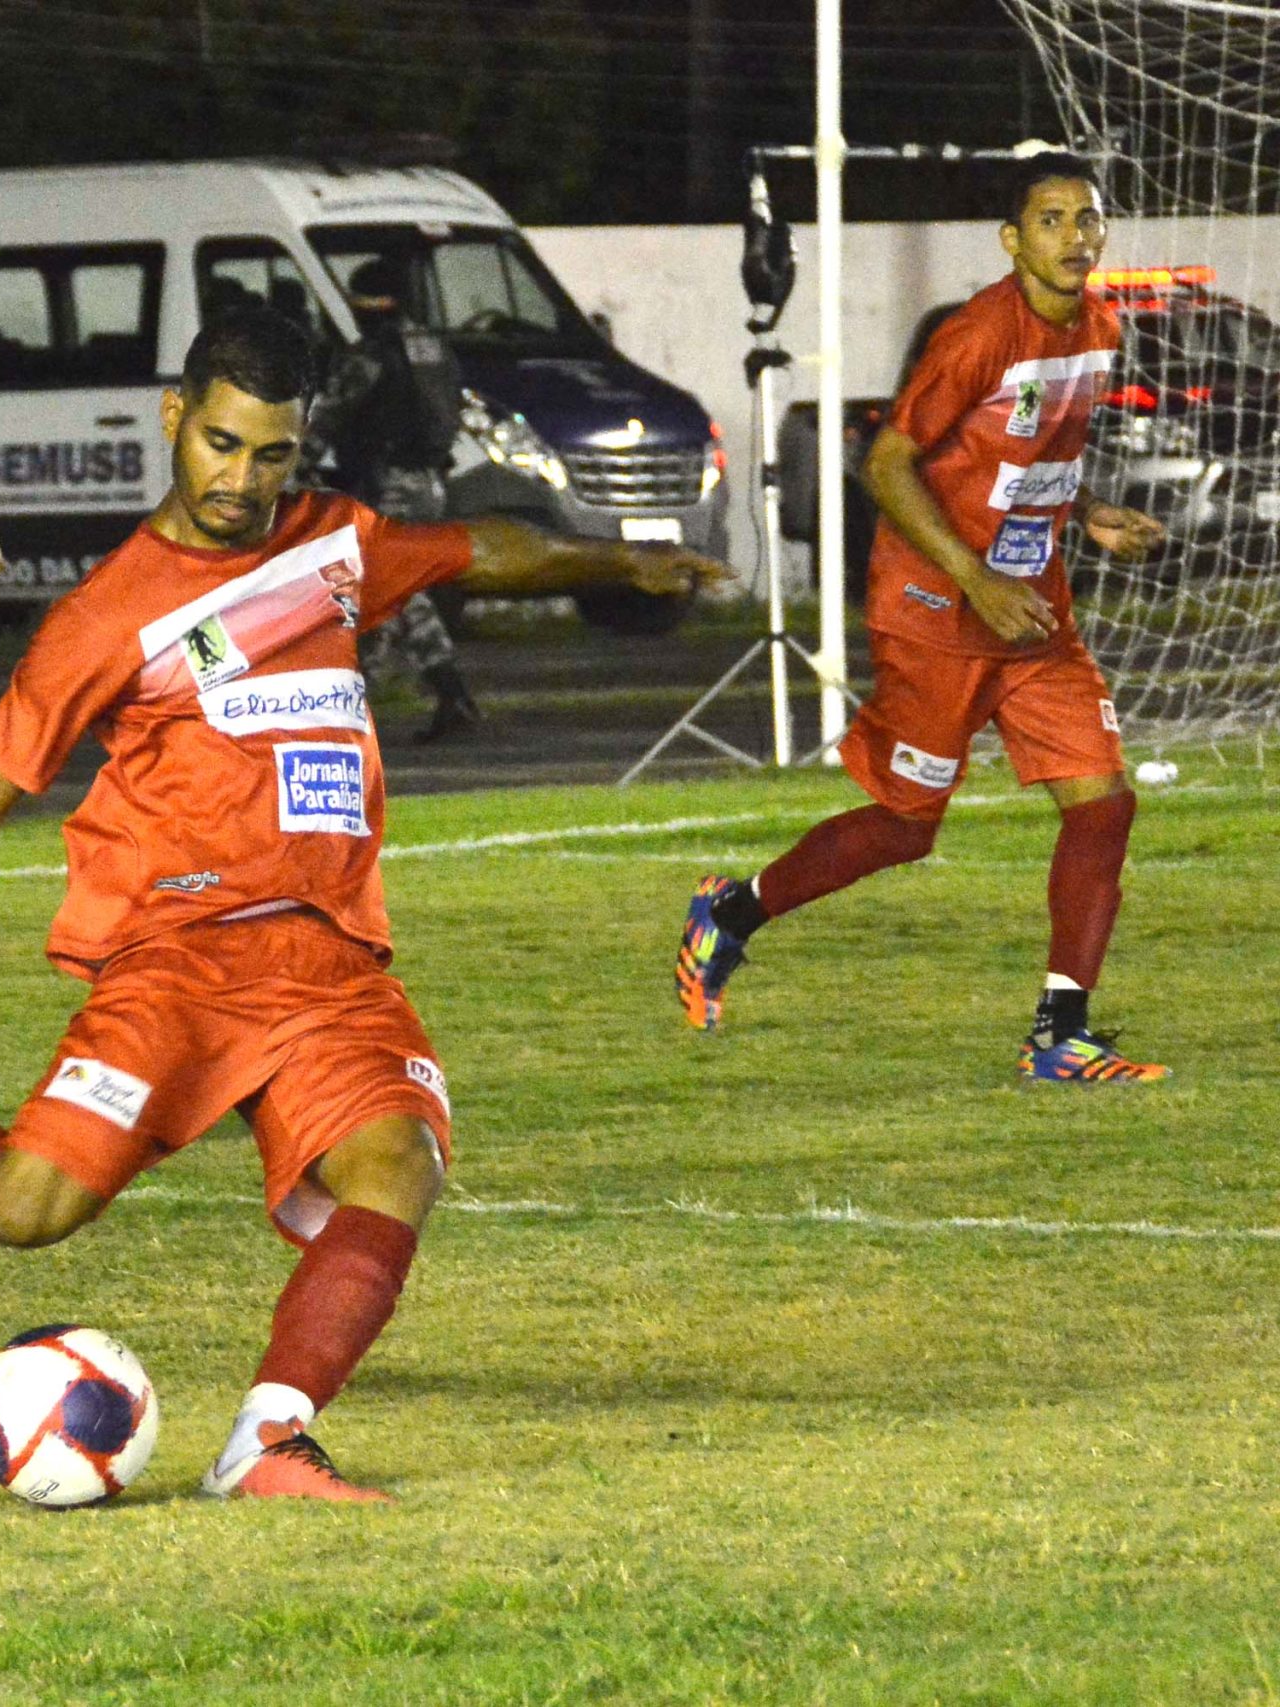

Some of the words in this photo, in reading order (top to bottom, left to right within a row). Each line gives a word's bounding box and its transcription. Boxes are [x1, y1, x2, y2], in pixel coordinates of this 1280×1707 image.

[223, 684, 354, 720] Elizabeth
[289, 756, 347, 783] Jornal
[289, 781, 361, 812] Paraíba
